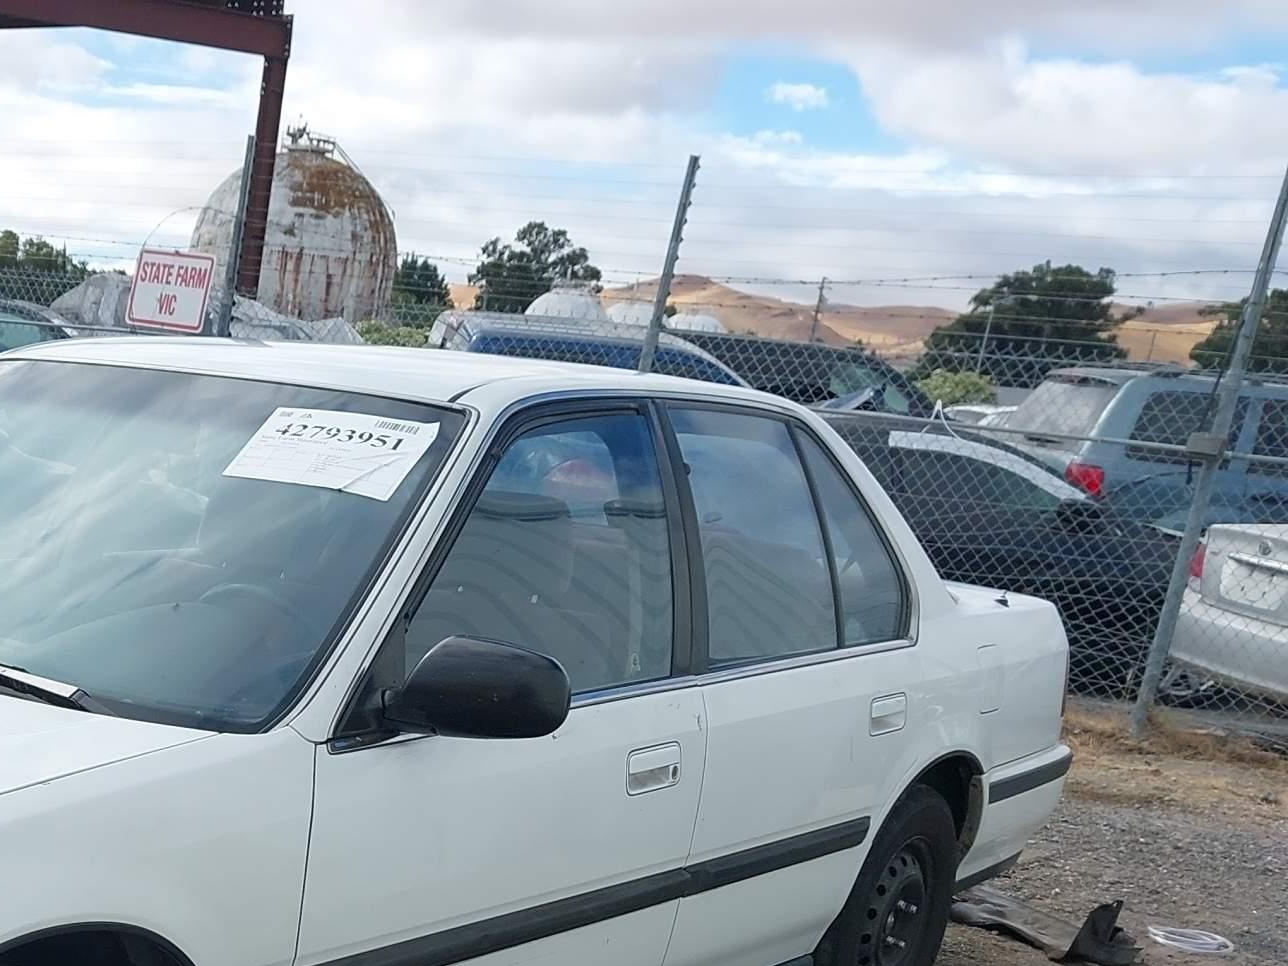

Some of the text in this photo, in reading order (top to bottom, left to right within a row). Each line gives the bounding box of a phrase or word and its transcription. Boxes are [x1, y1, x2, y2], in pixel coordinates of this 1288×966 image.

[140, 261, 209, 290] STATE FARM
[158, 291, 177, 316] VIC
[275, 422, 405, 451] 42793951
